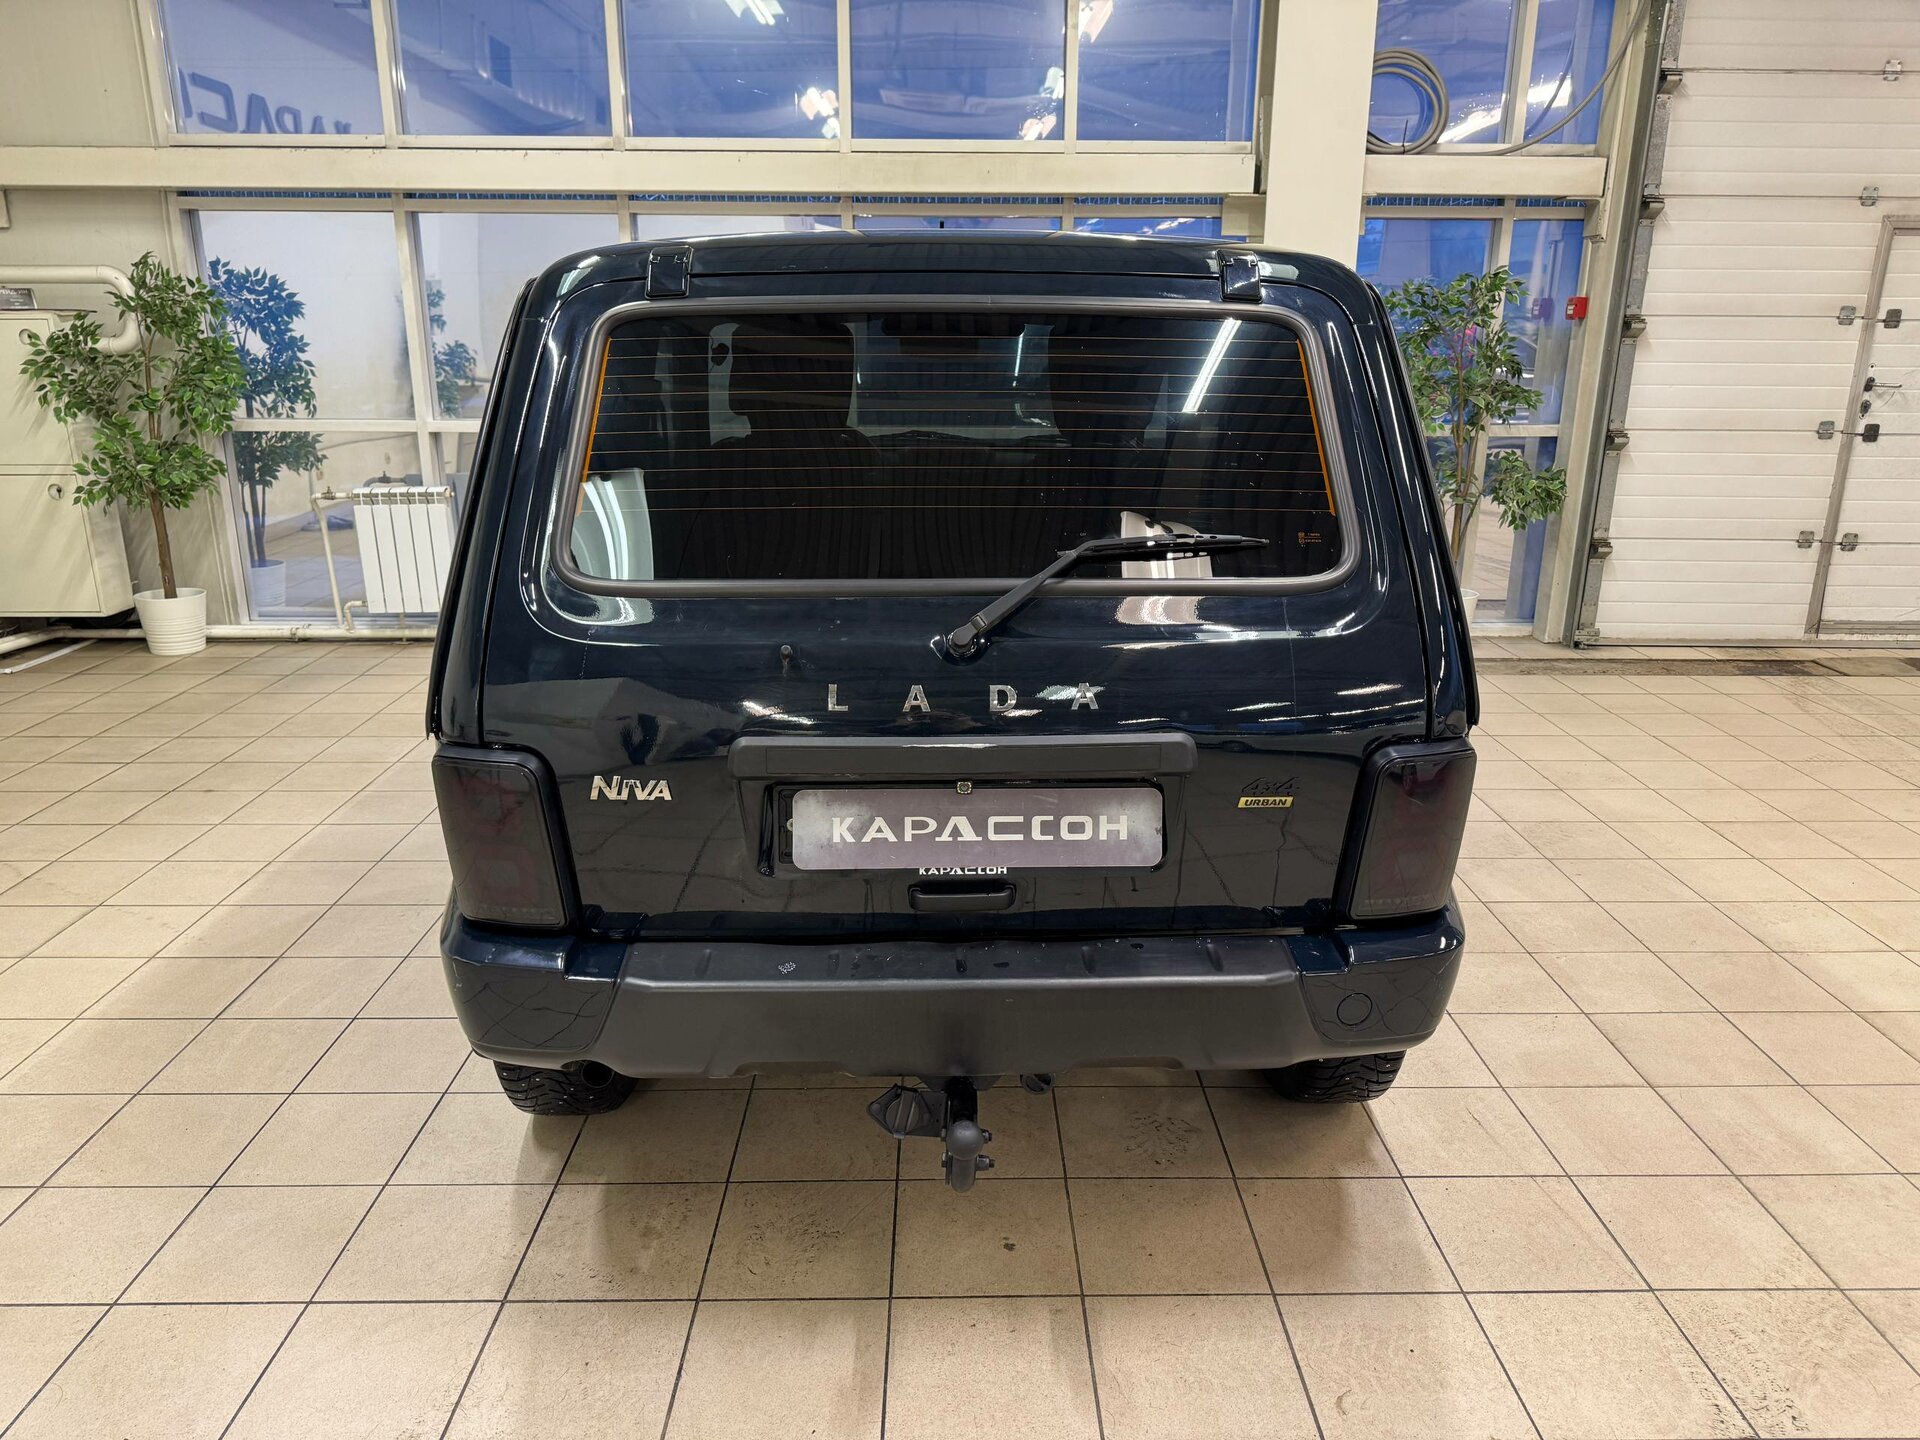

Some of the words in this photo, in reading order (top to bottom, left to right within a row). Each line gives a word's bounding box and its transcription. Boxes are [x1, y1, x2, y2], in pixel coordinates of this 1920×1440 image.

[828, 682, 1099, 712] LADA
[589, 775, 673, 801] NIVA
[1244, 798, 1287, 807] URBAN
[831, 815, 1128, 843] КАРАССОН
